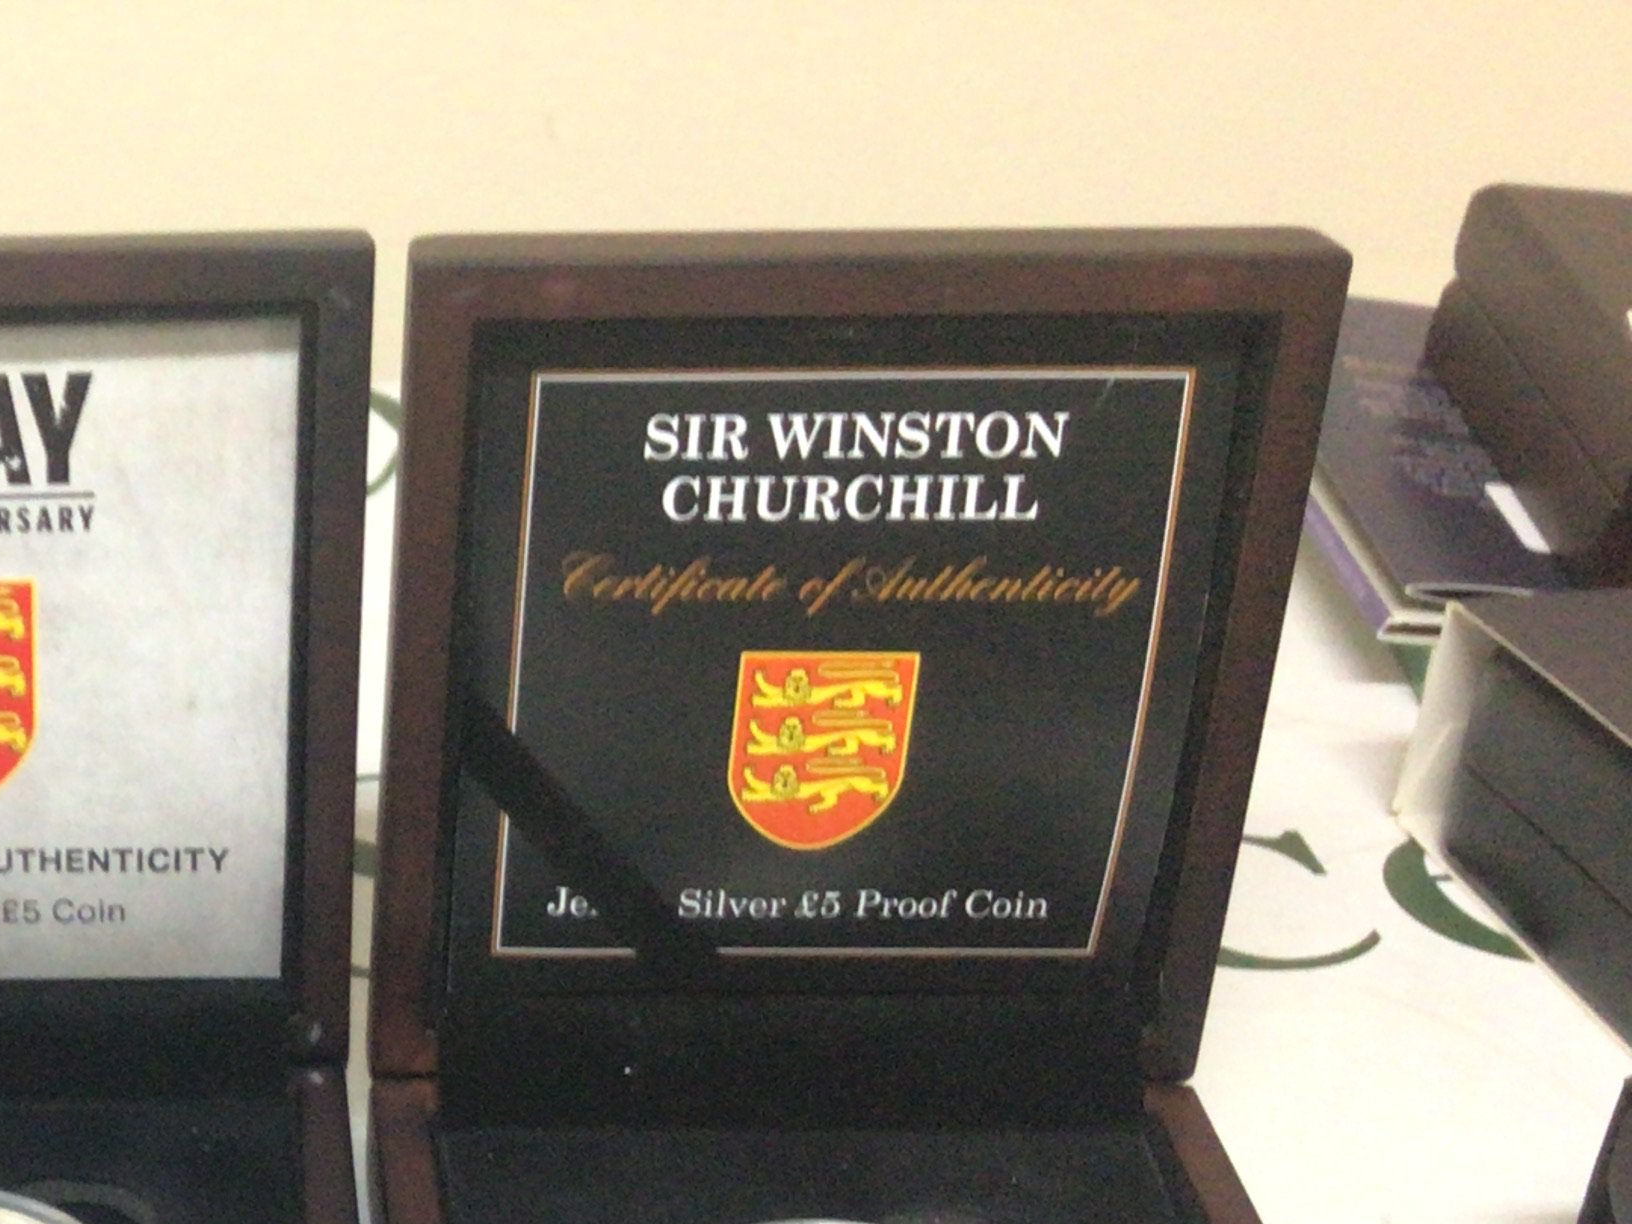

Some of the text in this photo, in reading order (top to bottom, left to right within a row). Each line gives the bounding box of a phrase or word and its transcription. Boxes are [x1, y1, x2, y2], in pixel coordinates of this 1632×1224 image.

[644, 410, 1070, 462] SIR WINSTON
[661, 473, 1040, 523] CHURCHILL
[562, 551, 1142, 618] Certificate of Authenticity
[2, 898, 42, 924] £5
[53, 896, 126, 925] Coin
[677, 887, 1050, 919] Silver £5 Proof Coin
